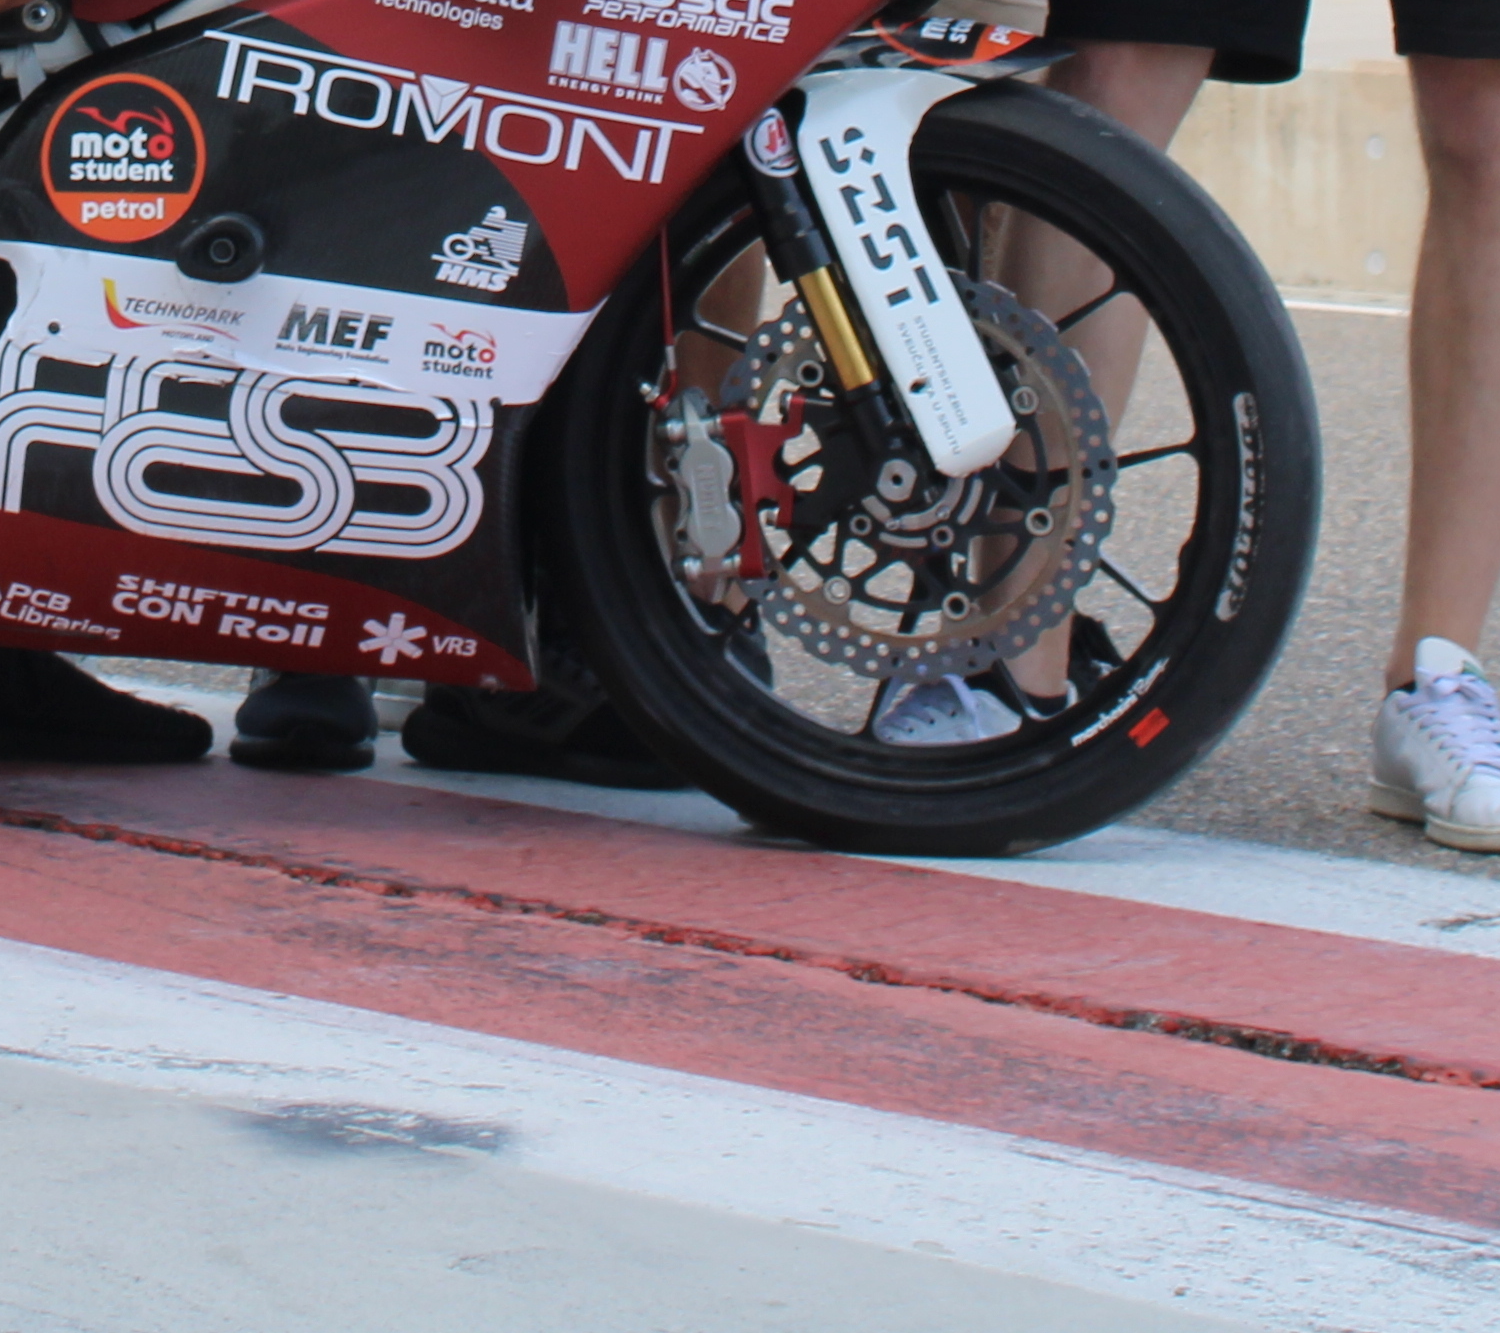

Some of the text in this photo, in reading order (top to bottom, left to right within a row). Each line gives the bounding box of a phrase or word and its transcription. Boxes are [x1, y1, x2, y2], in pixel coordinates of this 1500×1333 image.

[548, 19, 670, 94] HELL
[547, 75, 665, 105] ENERGY DRINK
[203, 29, 705, 185] TROMONT
[70, 126, 175, 160] moto
[69, 157, 174, 182] student
[81, 197, 165, 224] petrol
[435, 262, 511, 293] HMS
[277, 301, 394, 352] MEF
[423, 337, 496, 364] moto
[422, 359, 494, 379] student
[4, 581, 72, 613] PCB
[115, 573, 330, 620] SHIFTING
[0, 599, 122, 642] Libraries
[111, 591, 327, 648] CON Roll
[432, 633, 479, 658] VR3
